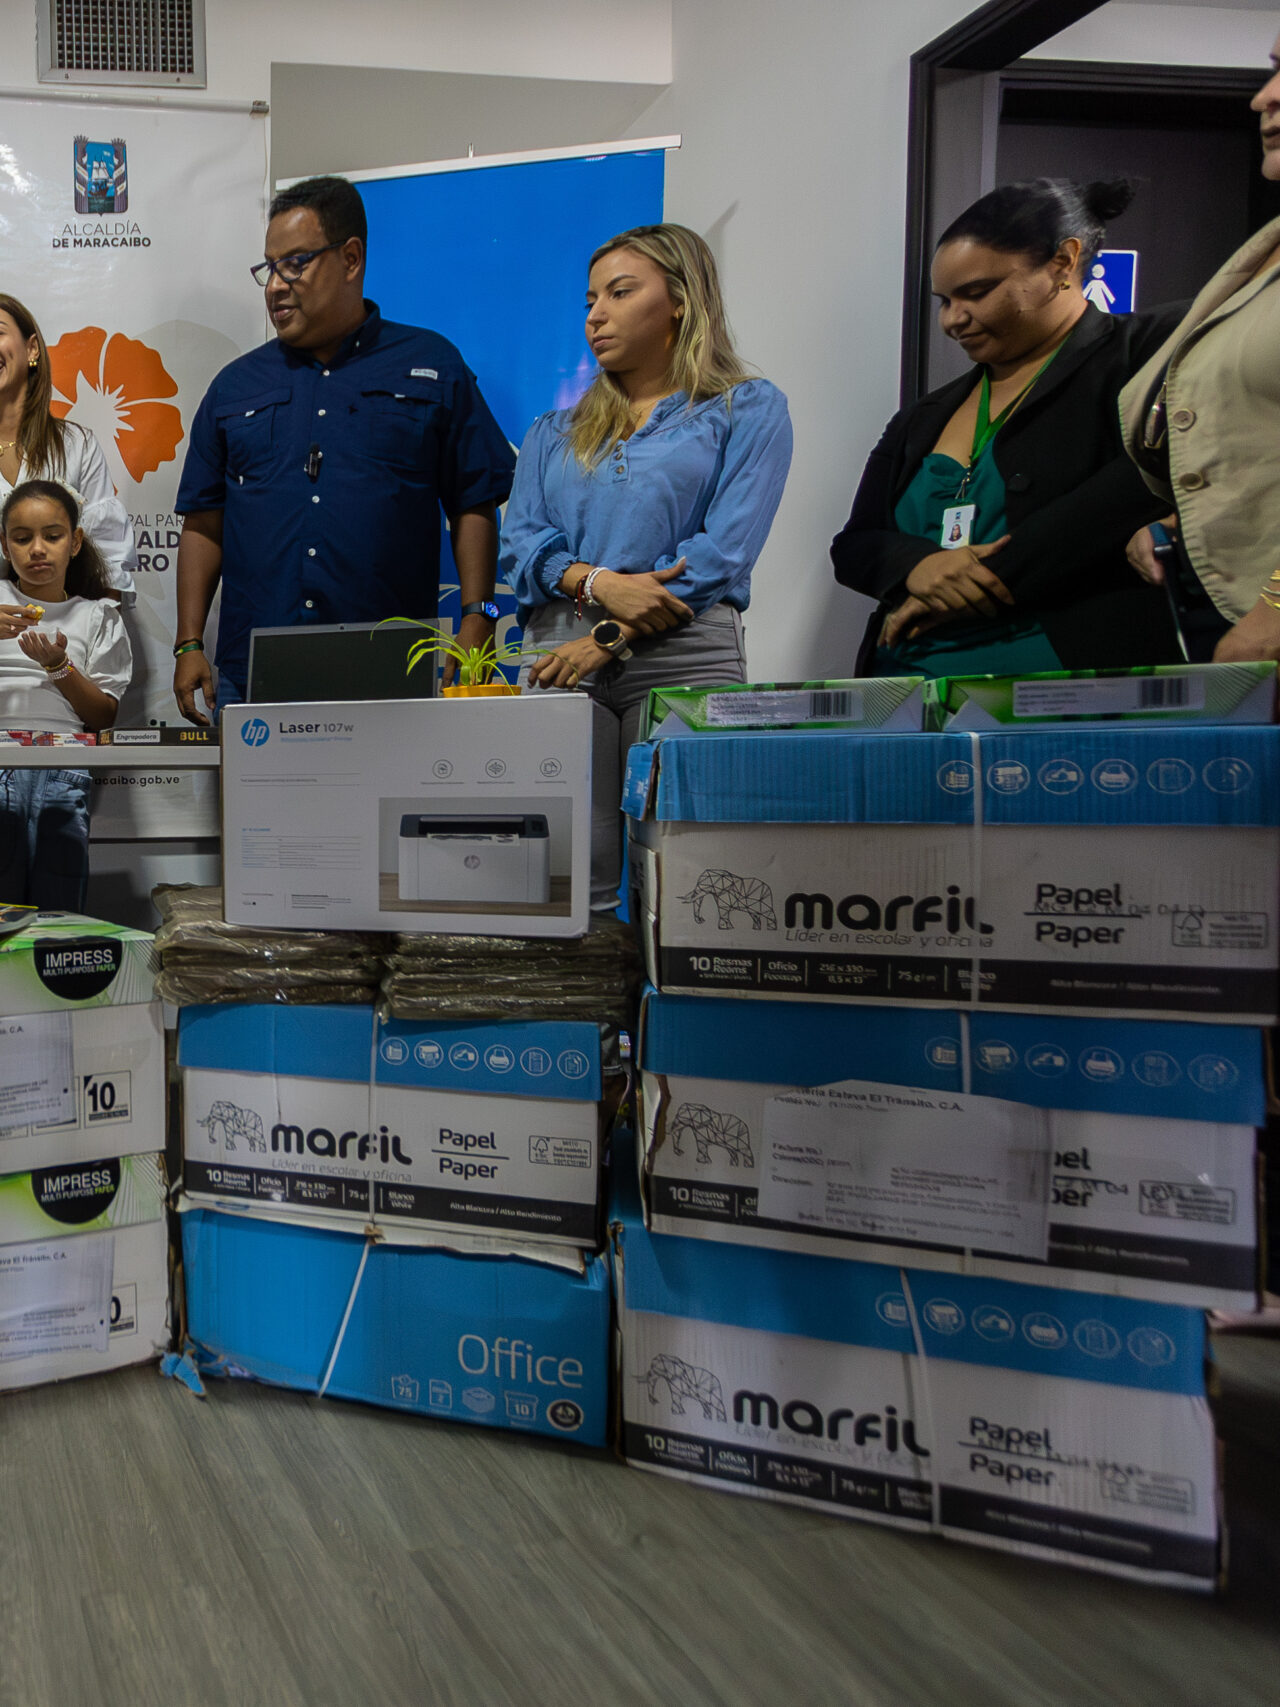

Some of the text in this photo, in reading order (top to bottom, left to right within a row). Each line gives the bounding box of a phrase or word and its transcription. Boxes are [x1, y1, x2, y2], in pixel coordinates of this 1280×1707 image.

[62, 219, 141, 236] ALCALDÍA
[52, 237, 151, 248] DE MARACAIBO
[133, 531, 180, 548] ALD
[129, 554, 169, 573] RO
[180, 731, 209, 741] BULL
[242, 718, 269, 747] hp
[279, 722, 354, 733] Laser 107w
[1036, 883, 1124, 910] Papel
[784, 885, 995, 935] marfil
[829, 931, 849, 943] en
[855, 933, 914, 945] escolar
[1035, 921, 1125, 948] Paper
[46, 948, 113, 968] IMPRESS
[689, 956, 710, 971] 10
[88, 1081, 115, 1112] 10
[271, 1123, 413, 1165] marfil
[439, 1128, 497, 1151] Papel
[206, 1169, 222, 1182] 10
[439, 1157, 498, 1180] Paper
[43, 1169, 112, 1193] IMPRESS
[669, 1186, 690, 1201] 10
[458, 1334, 584, 1389] Office
[515, 1403, 529, 1416] 10
[733, 1388, 930, 1458] marfil
[970, 1416, 1053, 1450] Papel
[645, 1433, 666, 1450] 10
[970, 1453, 1057, 1486] Paper
